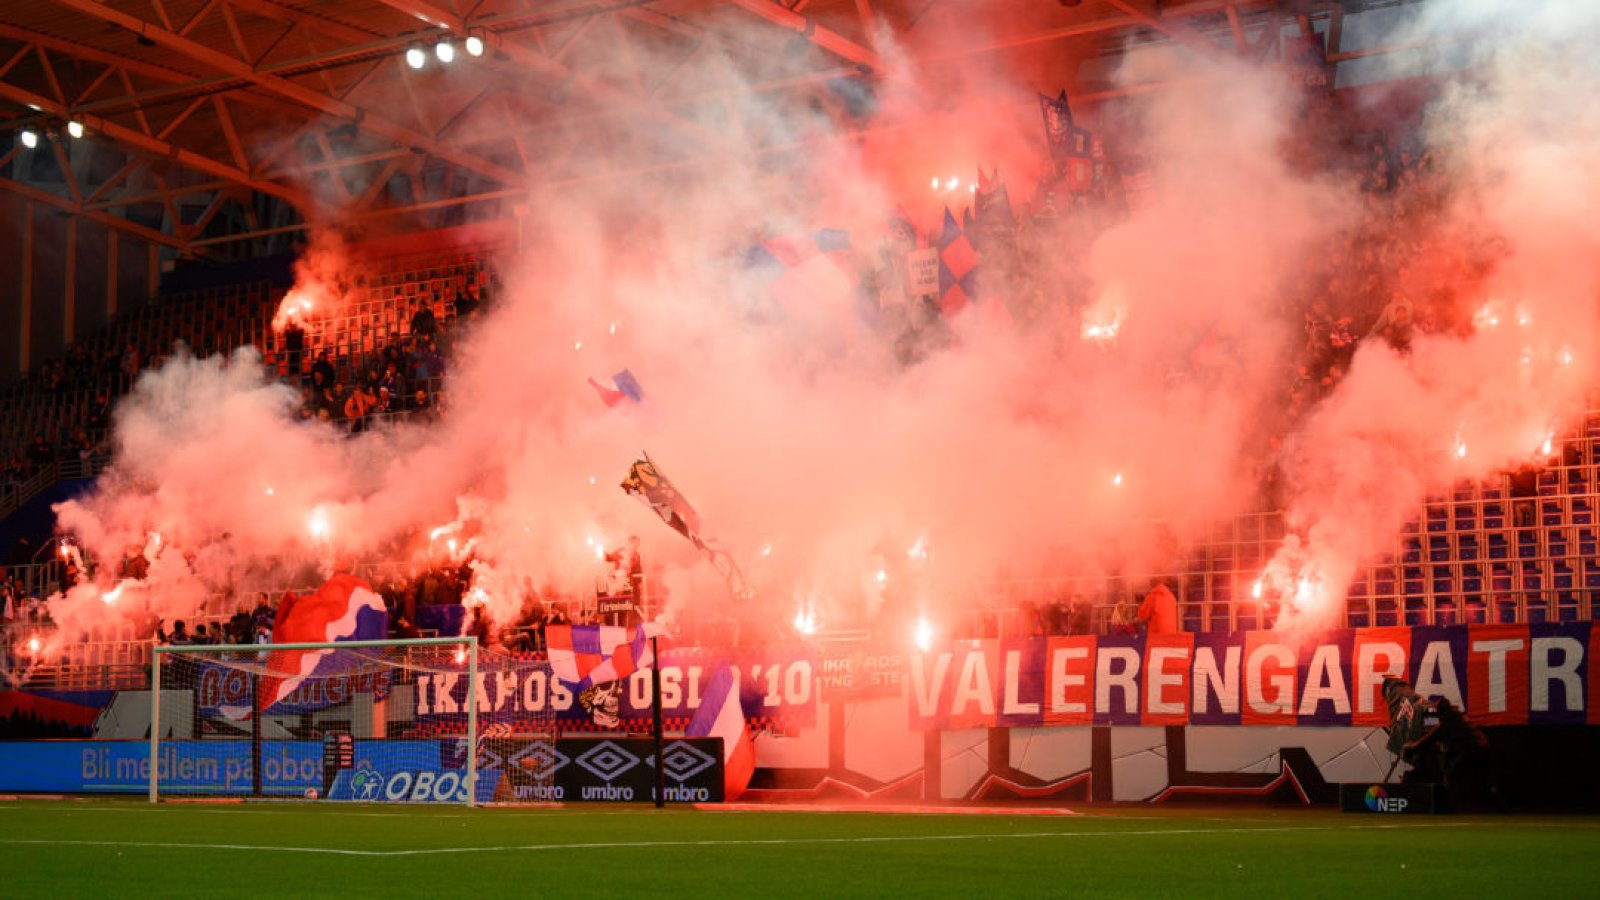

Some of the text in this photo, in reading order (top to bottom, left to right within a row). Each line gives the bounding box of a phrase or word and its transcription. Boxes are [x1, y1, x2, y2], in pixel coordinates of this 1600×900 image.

[82, 747, 111, 780] Bli
[116, 747, 218, 780] medlem
[385, 771, 480, 801] OBOS
[514, 783, 565, 799] umbro
[581, 784, 634, 800] umbro
[1378, 798, 1408, 812] NEP
